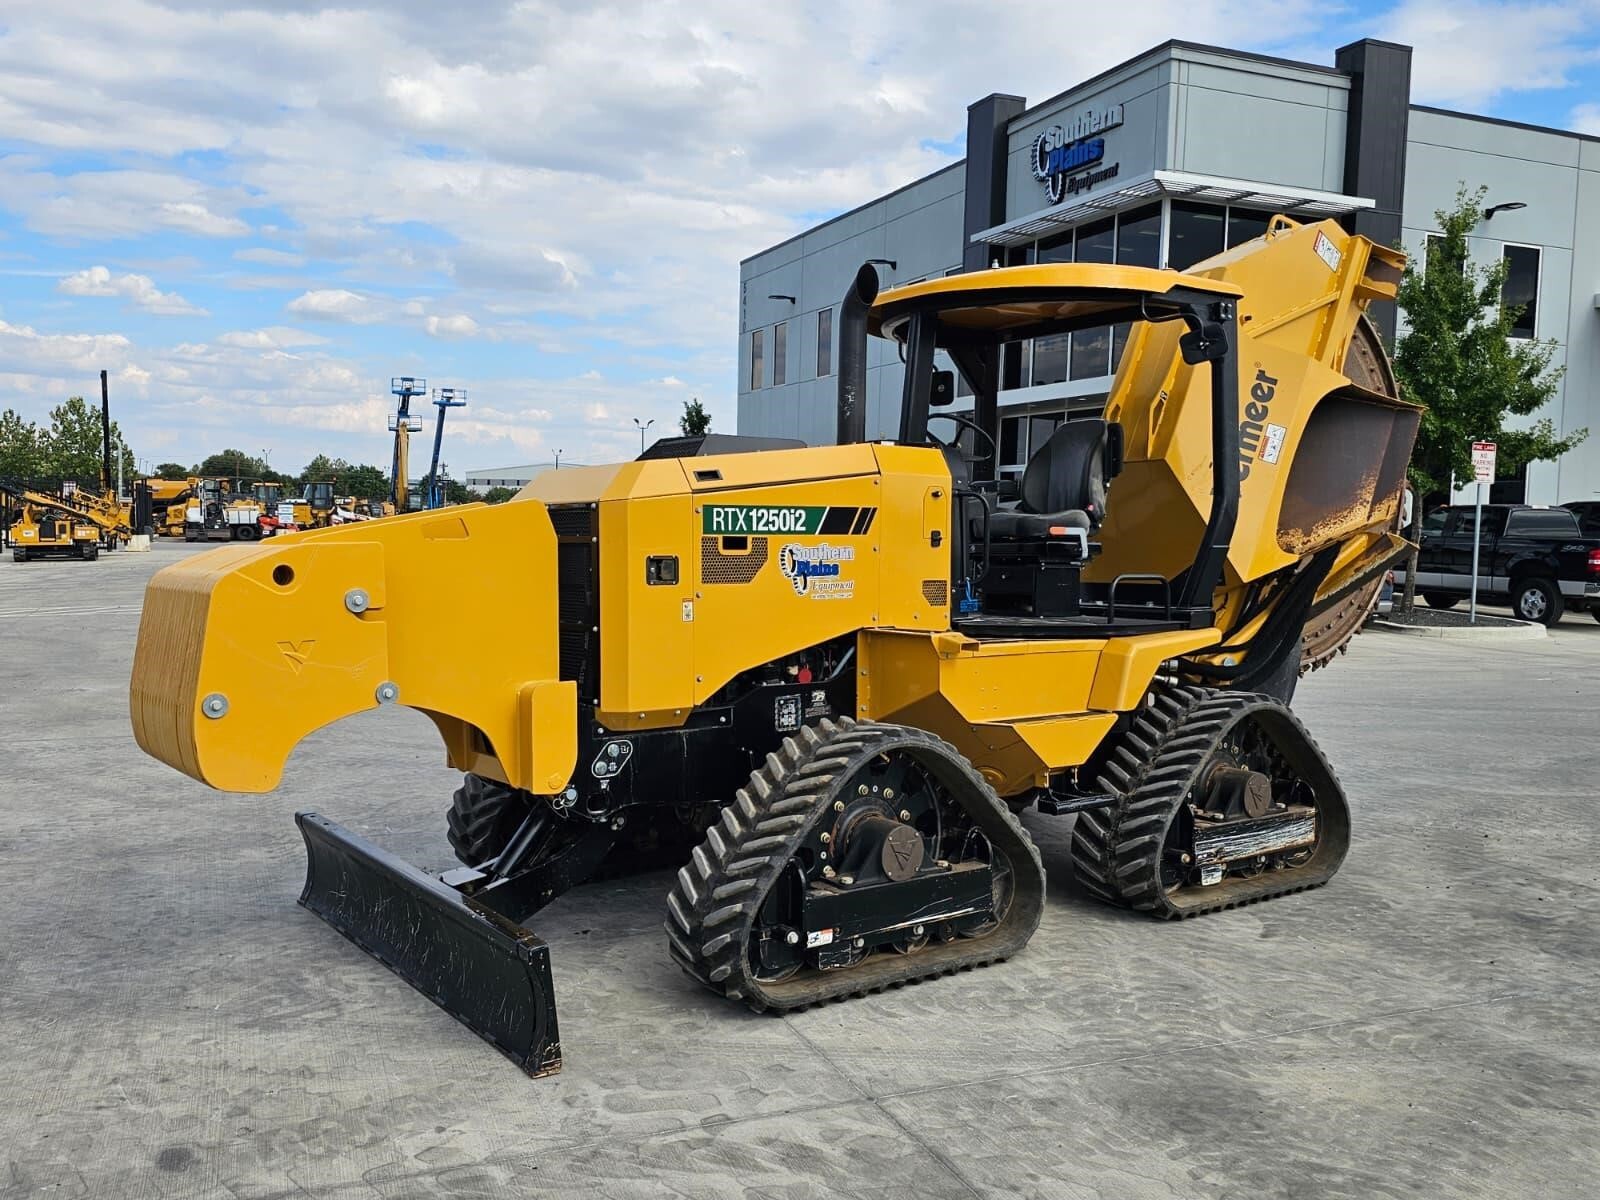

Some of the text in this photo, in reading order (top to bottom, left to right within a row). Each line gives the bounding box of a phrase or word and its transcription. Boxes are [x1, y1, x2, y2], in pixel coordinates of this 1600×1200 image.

[1044, 104, 1123, 152] Southern
[1048, 138, 1104, 175] Plains
[1066, 162, 1119, 194] Equipment
[712, 508, 806, 531] RTX1250i2
[793, 544, 854, 560] Southern
[797, 560, 839, 577] Plains
[811, 581, 855, 592] Equipment
